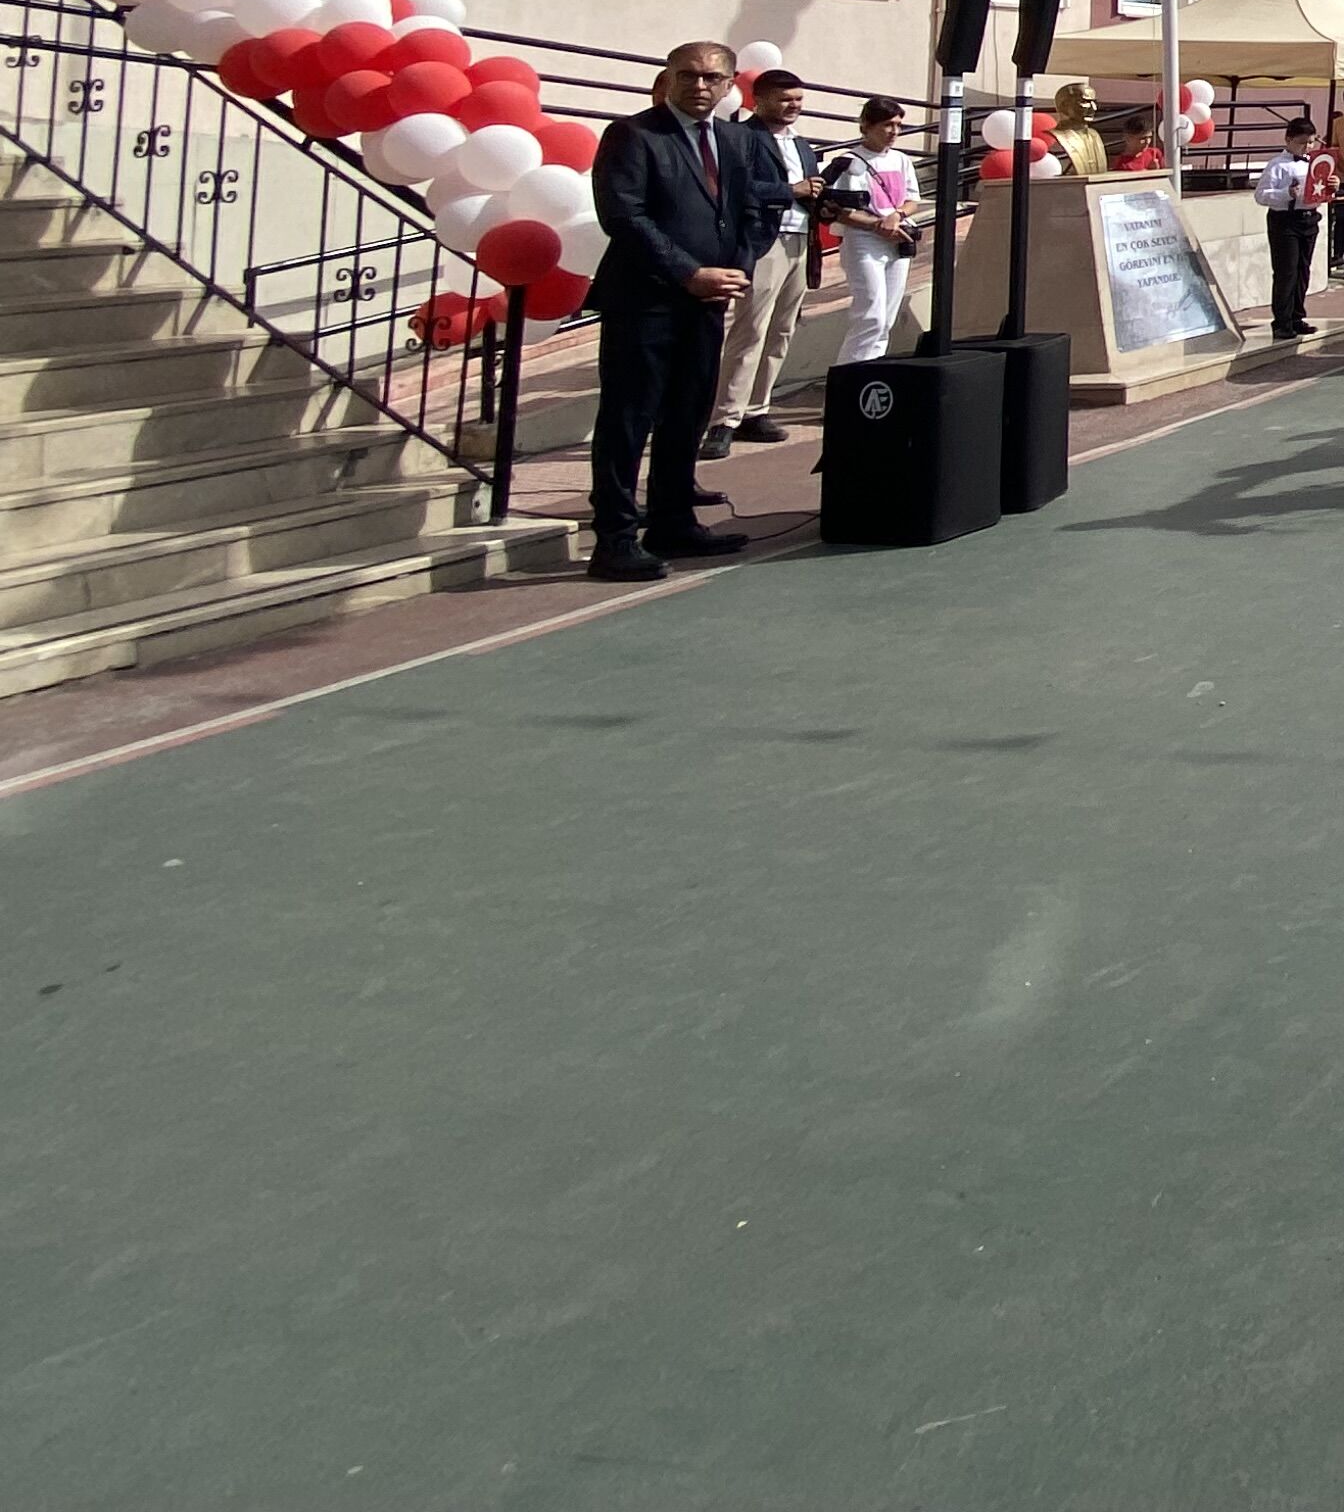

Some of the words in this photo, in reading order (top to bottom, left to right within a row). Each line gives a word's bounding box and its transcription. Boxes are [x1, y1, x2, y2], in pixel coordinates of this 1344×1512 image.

[1116, 243, 1128, 252] EN
[1130, 240, 1149, 252] ÇOK
[1151, 236, 1178, 247] SEVEN
